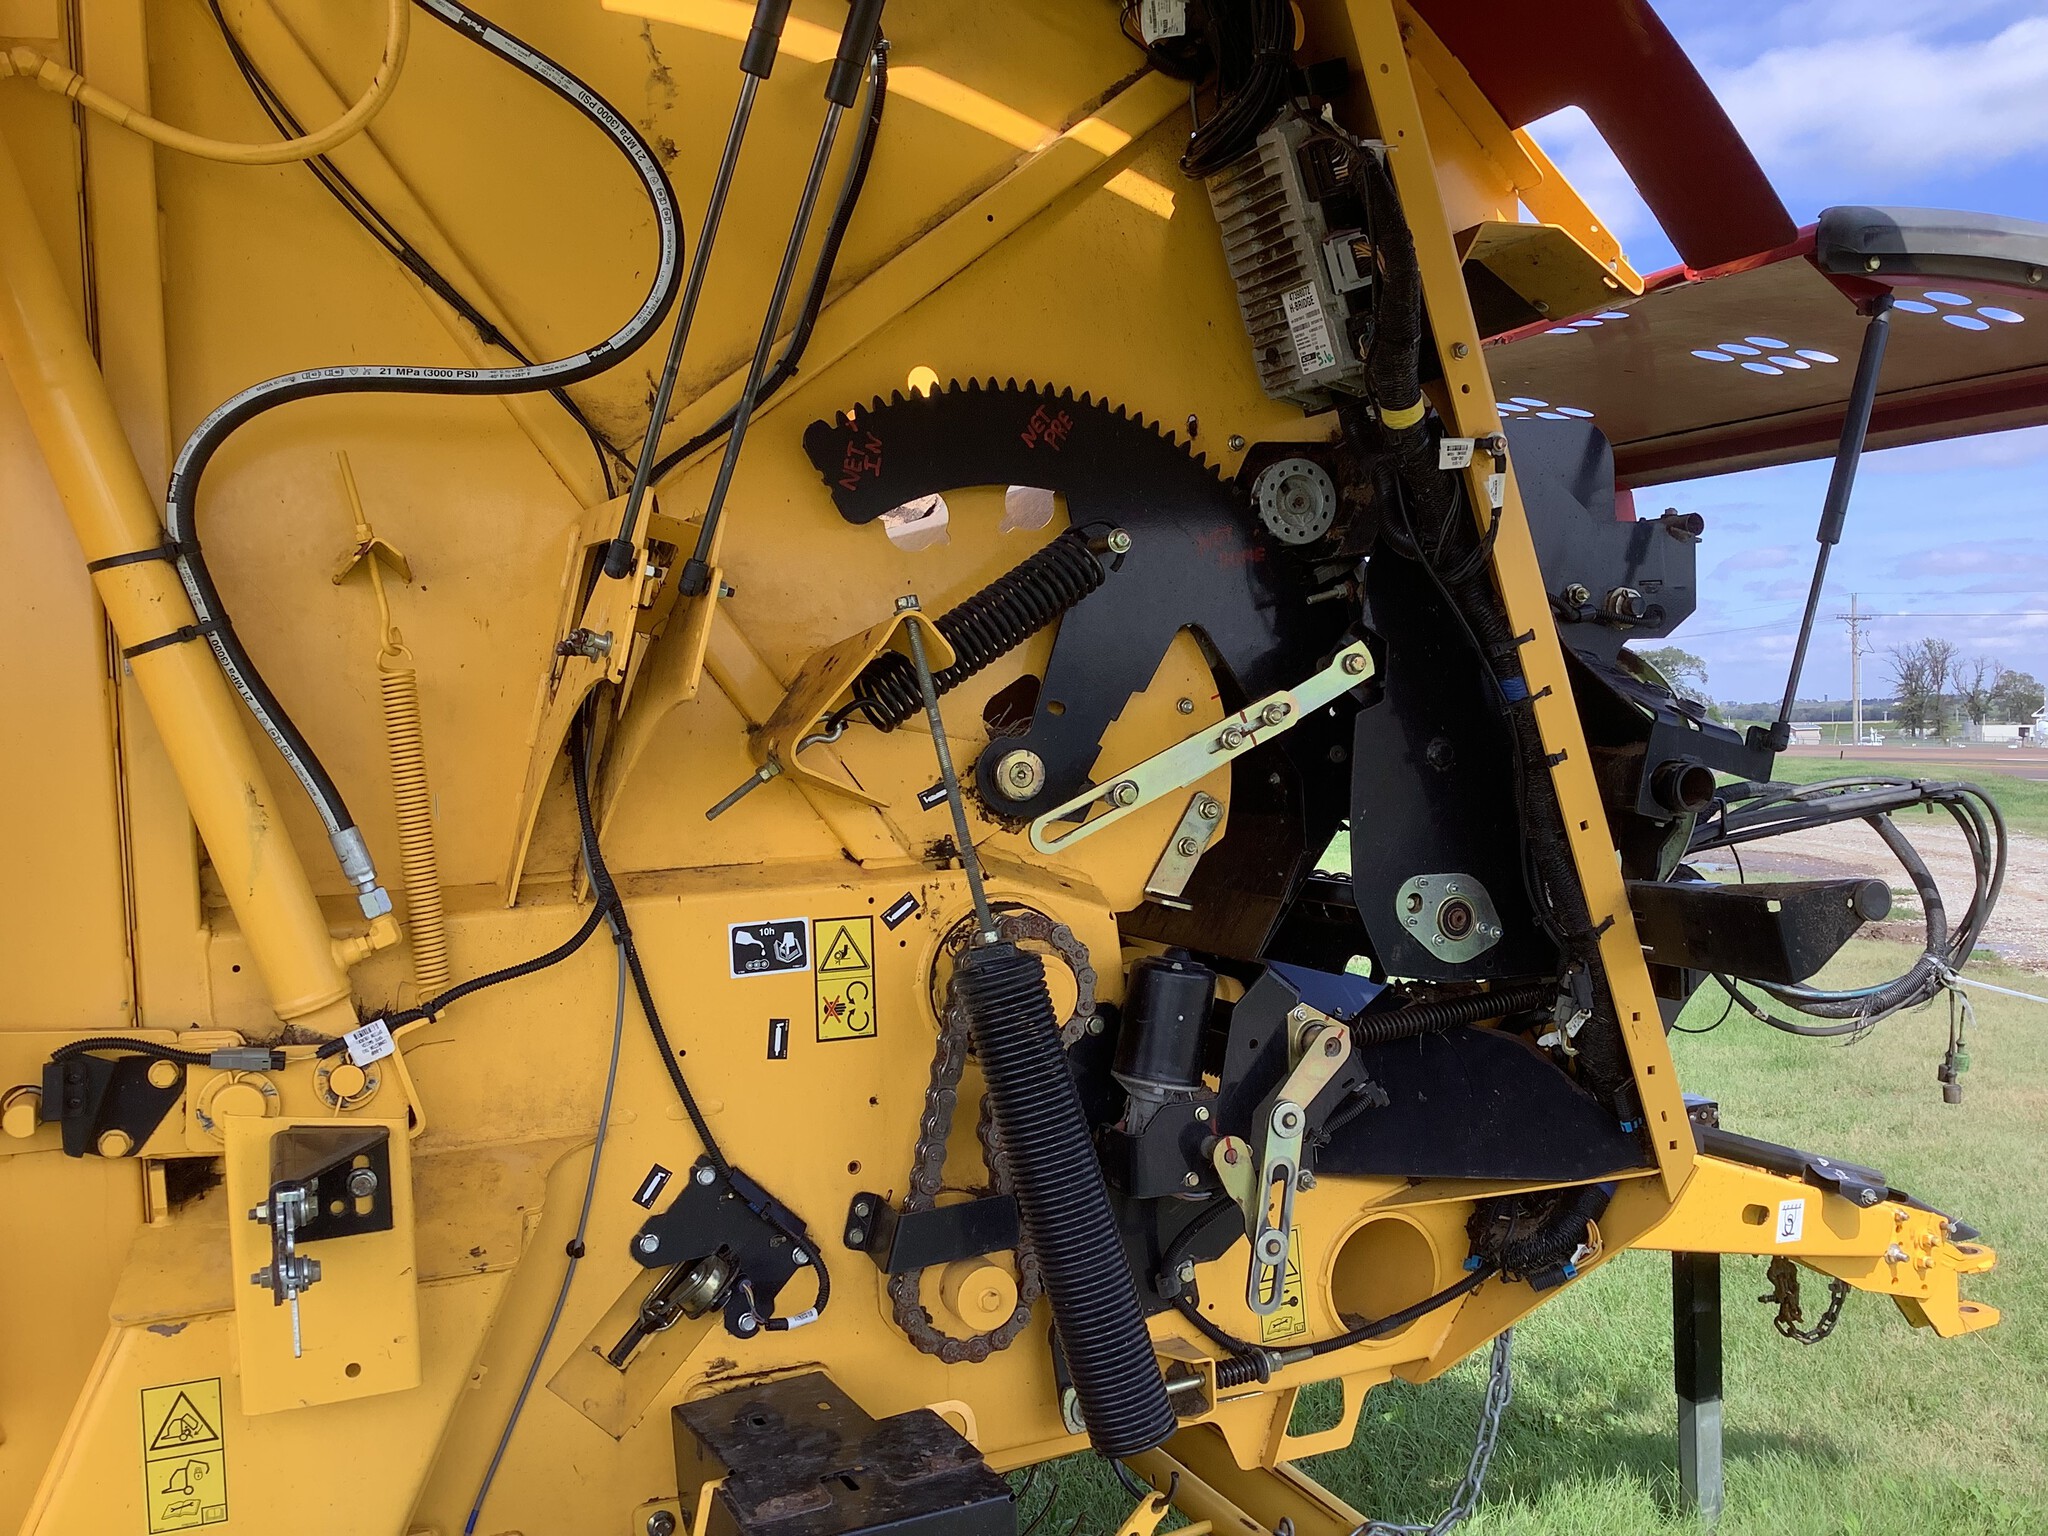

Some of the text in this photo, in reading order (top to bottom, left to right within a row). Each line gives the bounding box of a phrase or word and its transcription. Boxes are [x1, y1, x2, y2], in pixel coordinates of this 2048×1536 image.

[461, 15, 484, 33] Parker
[578, 91, 646, 161] 21 MPa (3000 PSI)
[1289, 295, 1315, 313] H-BRIDGE
[588, 345, 612, 358] Parker
[379, 367, 479, 379] 21 MPa (3000 PSI)
[1021, 404, 1050, 448] NET
[1044, 410, 1073, 451] PRE
[839, 440, 865, 491] NET
[864, 431, 882, 477] IN
[169, 473, 179, 502] Parker
[212, 640, 230, 666] (3000
[228, 668, 244, 689] MPa
[242, 691, 253, 703] 21
[759, 927, 775, 936] 10h
